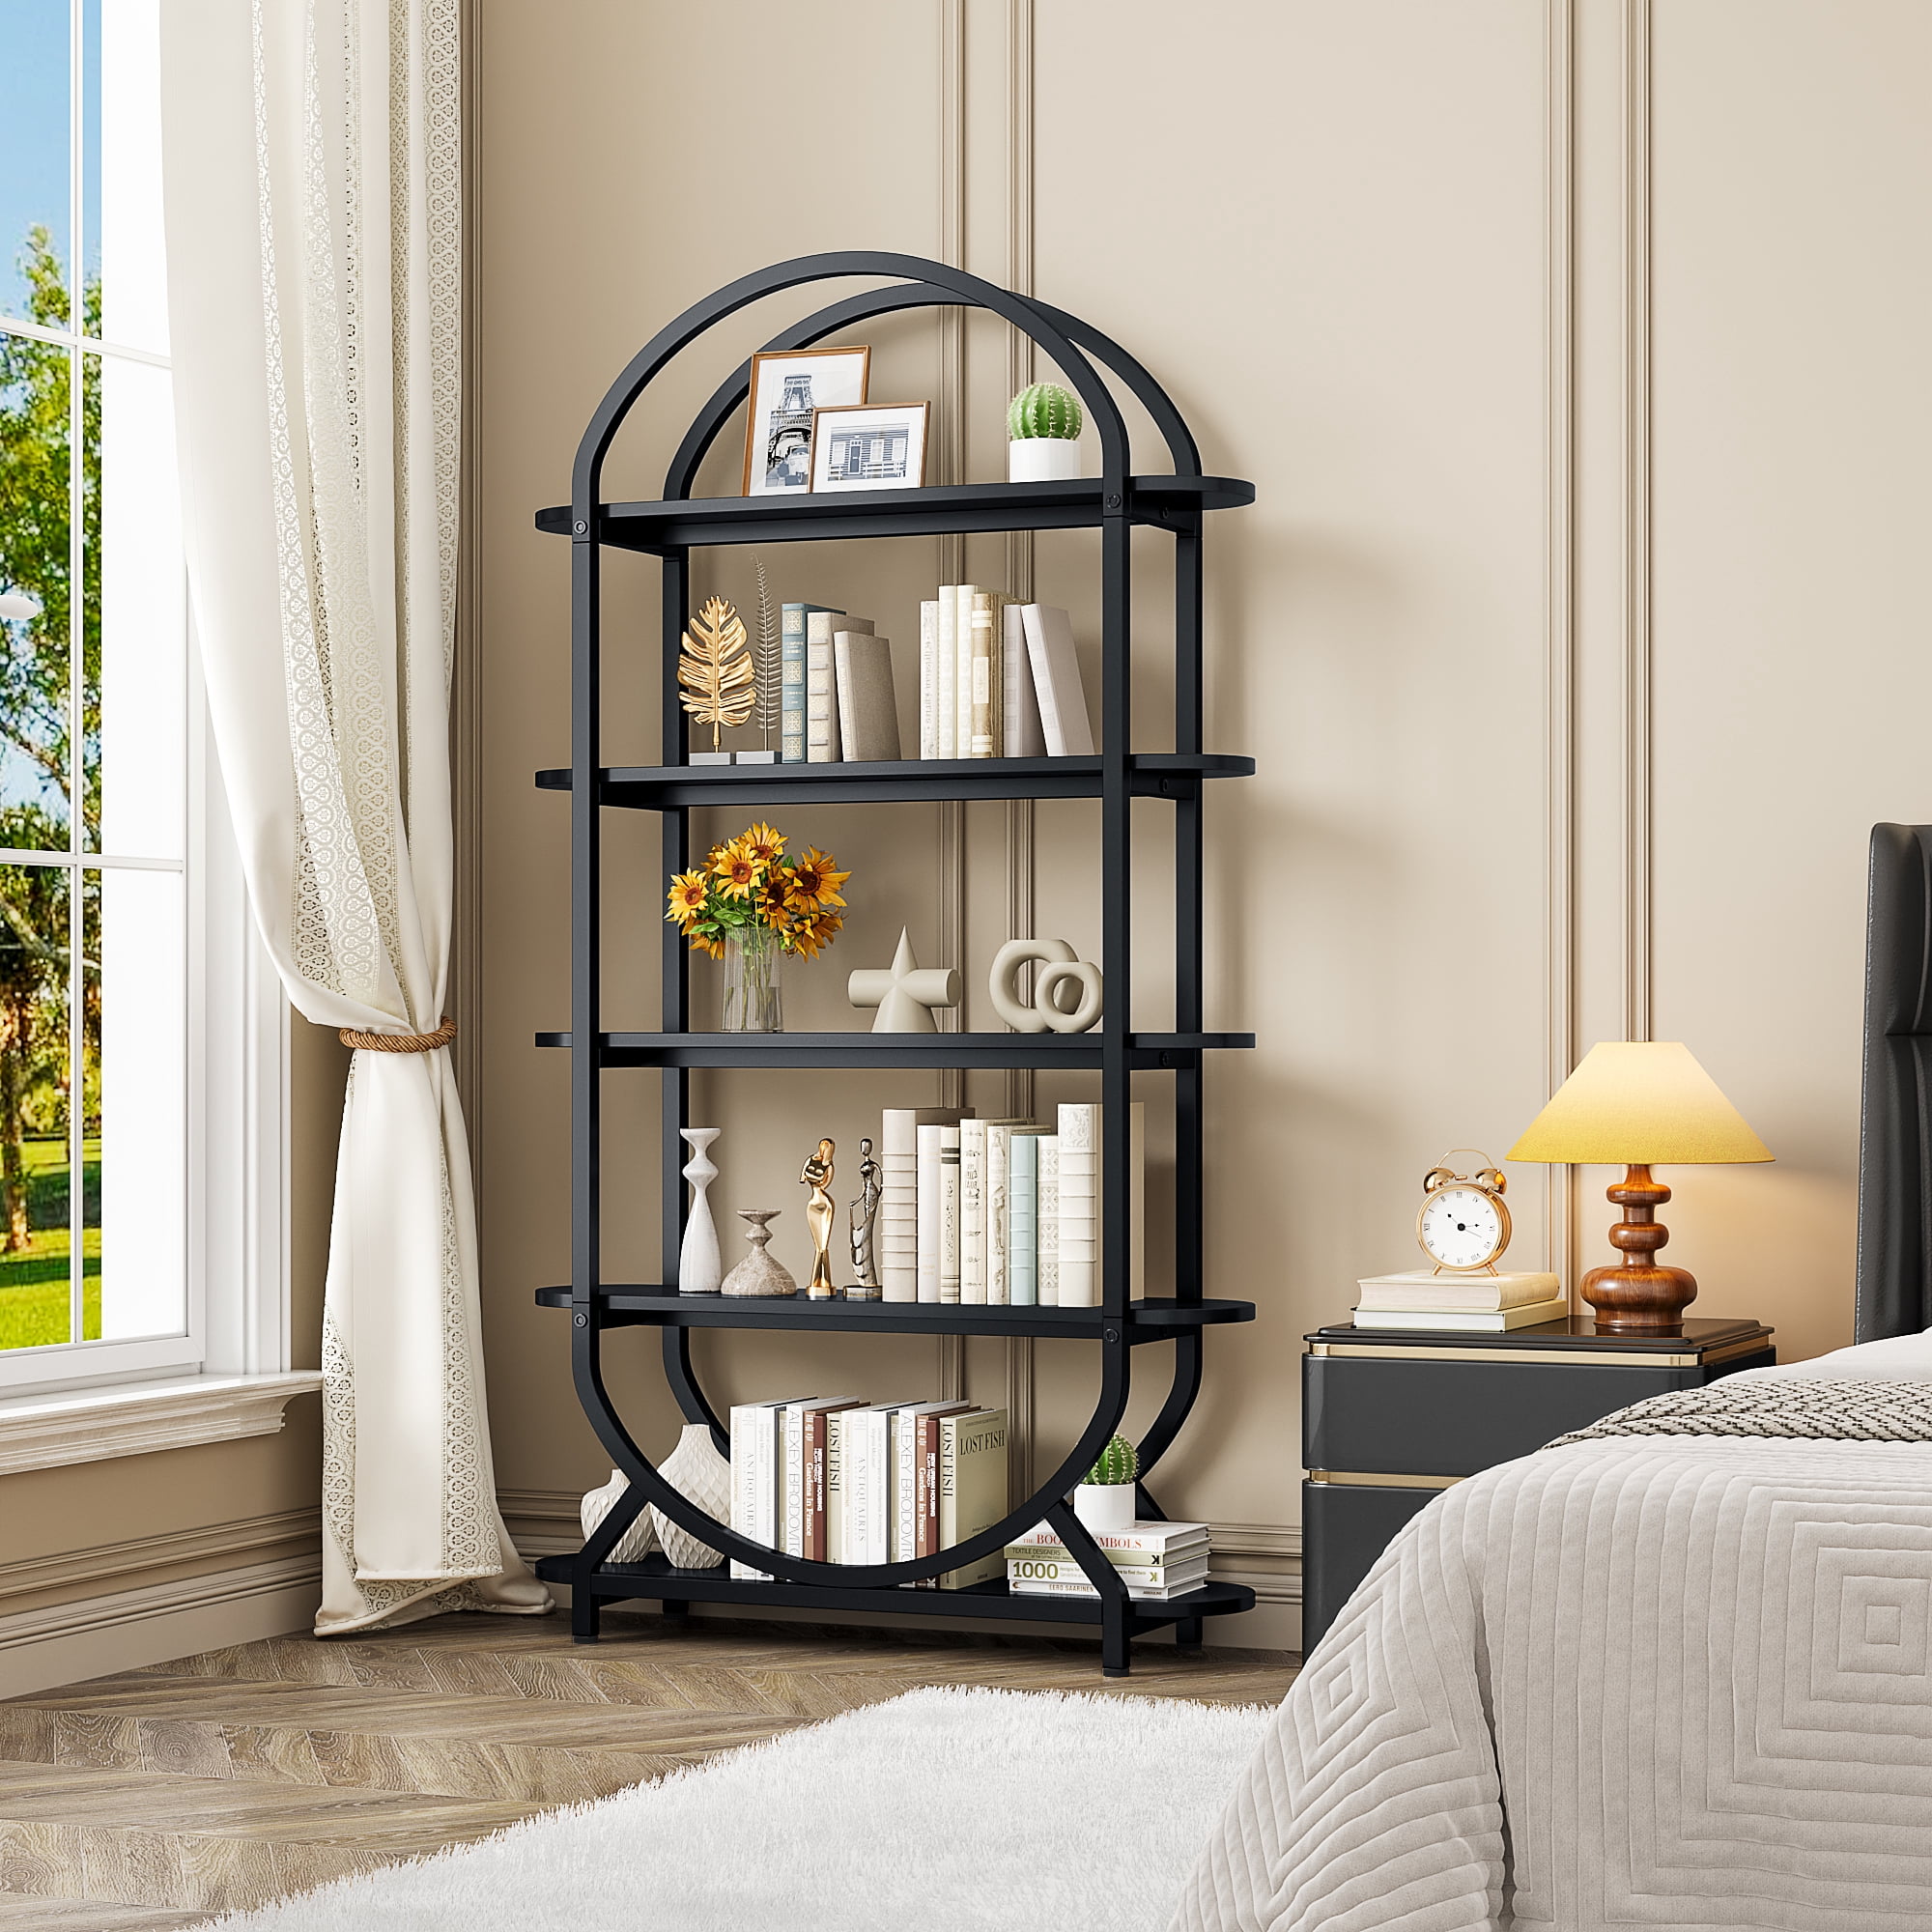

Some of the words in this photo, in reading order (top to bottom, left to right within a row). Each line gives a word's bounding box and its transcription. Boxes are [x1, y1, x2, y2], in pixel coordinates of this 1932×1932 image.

[789, 1411, 800, 1470] ALEXEY
[829, 1419, 840, 1457] LOST
[901, 1415, 912, 1474] ALEXEY
[942, 1424, 953, 1461] LOST
[960, 1434, 983, 1455] LOST
[985, 1429, 1004, 1450] FISH
[829, 1460, 840, 1491] FISH
[942, 1465, 953, 1496] FISH
[789, 1474, 800, 1557] BRODOVITC
[857, 1456, 866, 1542] ANTIQUAIRES
[901, 1479, 912, 1562] BRODOVITC
[1037, 1534, 1062, 1545] BOO
[1013, 1561, 1058, 1579] 1000
